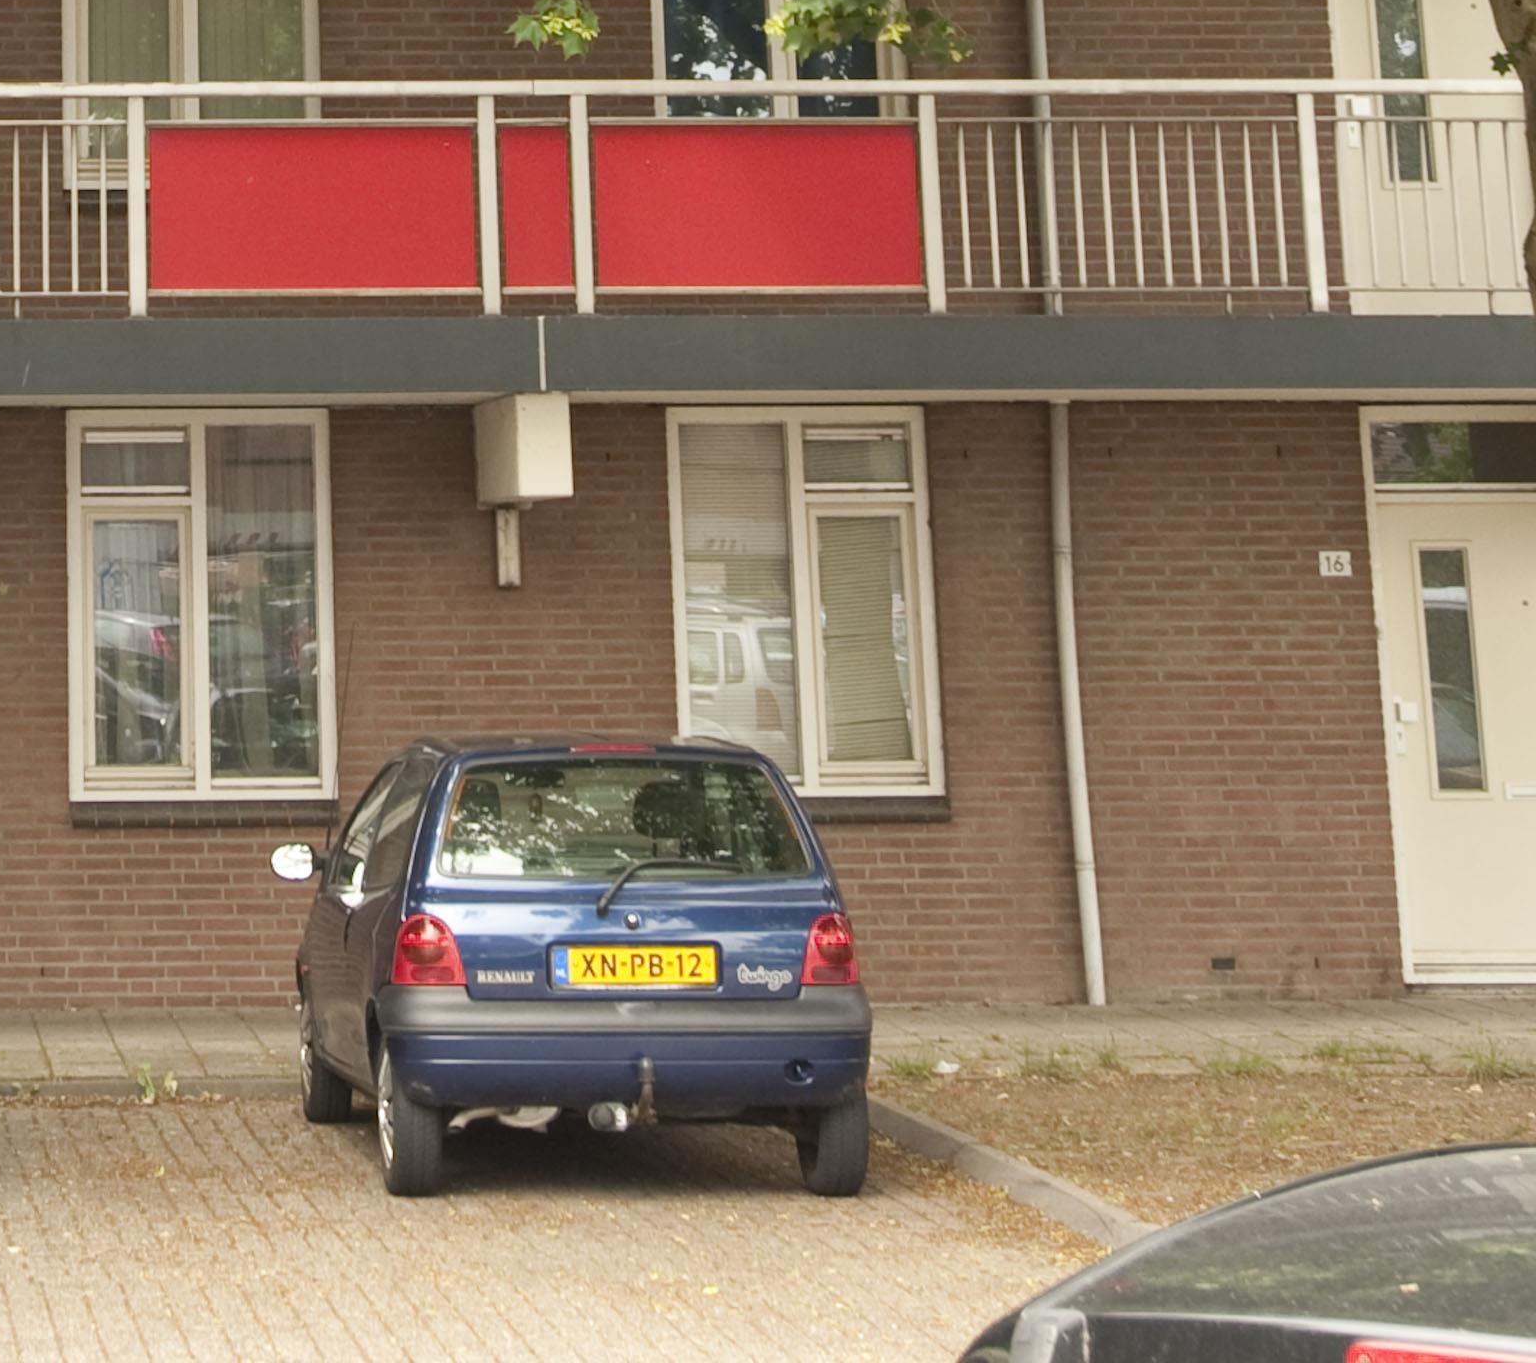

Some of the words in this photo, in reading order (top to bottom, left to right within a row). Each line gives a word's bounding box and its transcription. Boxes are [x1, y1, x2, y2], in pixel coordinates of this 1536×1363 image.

[1324, 555, 1345, 573] 16
[581, 953, 703, 978] XN-PB-12
[477, 970, 535, 984] RENAULT
[736, 962, 793, 992] twingo
